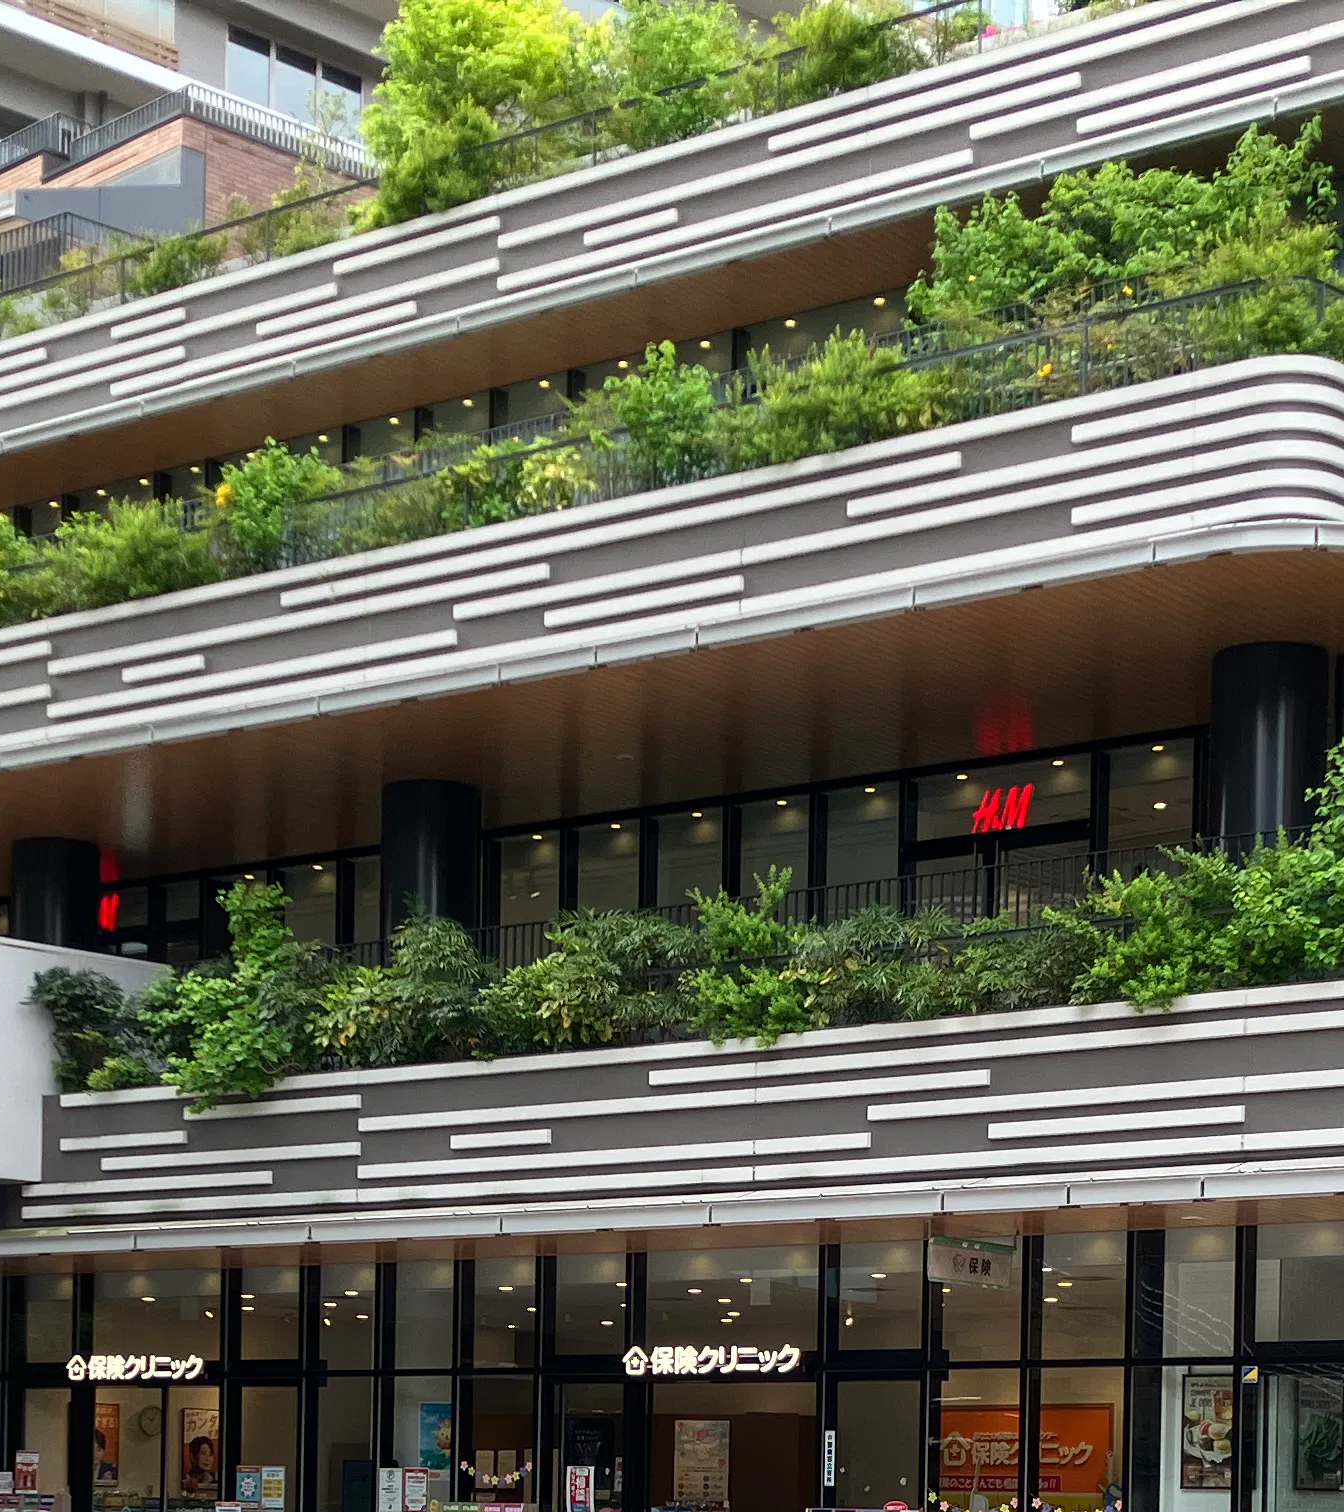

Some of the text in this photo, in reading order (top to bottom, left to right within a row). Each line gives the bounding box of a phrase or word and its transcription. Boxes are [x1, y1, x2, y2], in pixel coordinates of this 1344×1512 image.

[969, 1257, 992, 1277] 保険
[88, 1354, 203, 1380] 保険クリニック
[650, 1343, 800, 1375] 保険クリニック
